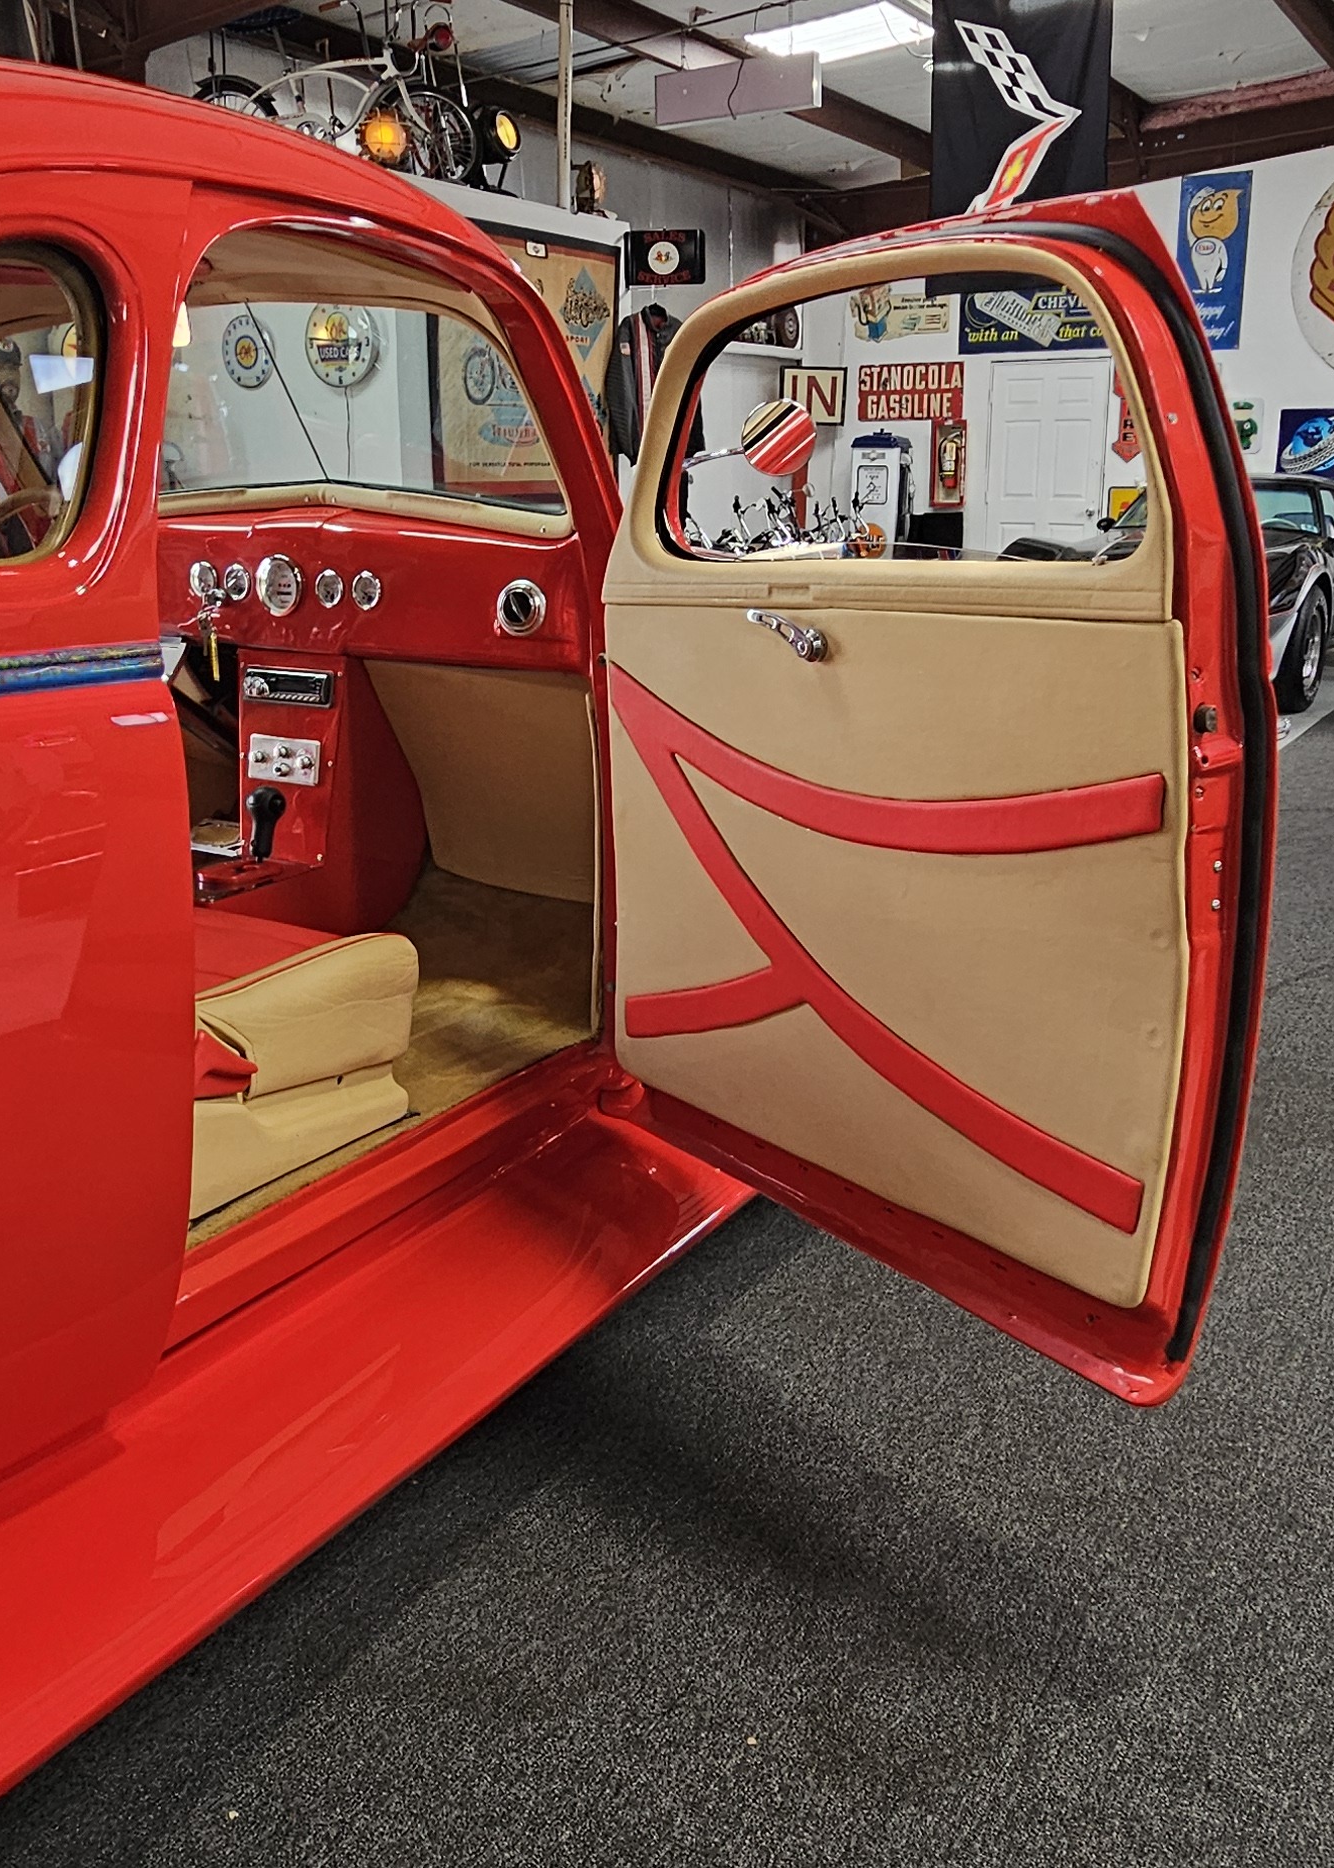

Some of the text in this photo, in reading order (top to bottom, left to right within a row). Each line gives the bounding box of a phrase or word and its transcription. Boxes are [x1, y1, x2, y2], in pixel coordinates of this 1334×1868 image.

[1037, 295, 1087, 310] CHEV
[1001, 330, 1019, 341] an
[1059, 325, 1085, 339] that
[319, 346, 339, 358] USED
[860, 364, 963, 391] STANOCOLA
[791, 374, 838, 417] IN
[867, 393, 952, 419] GASOLINE
